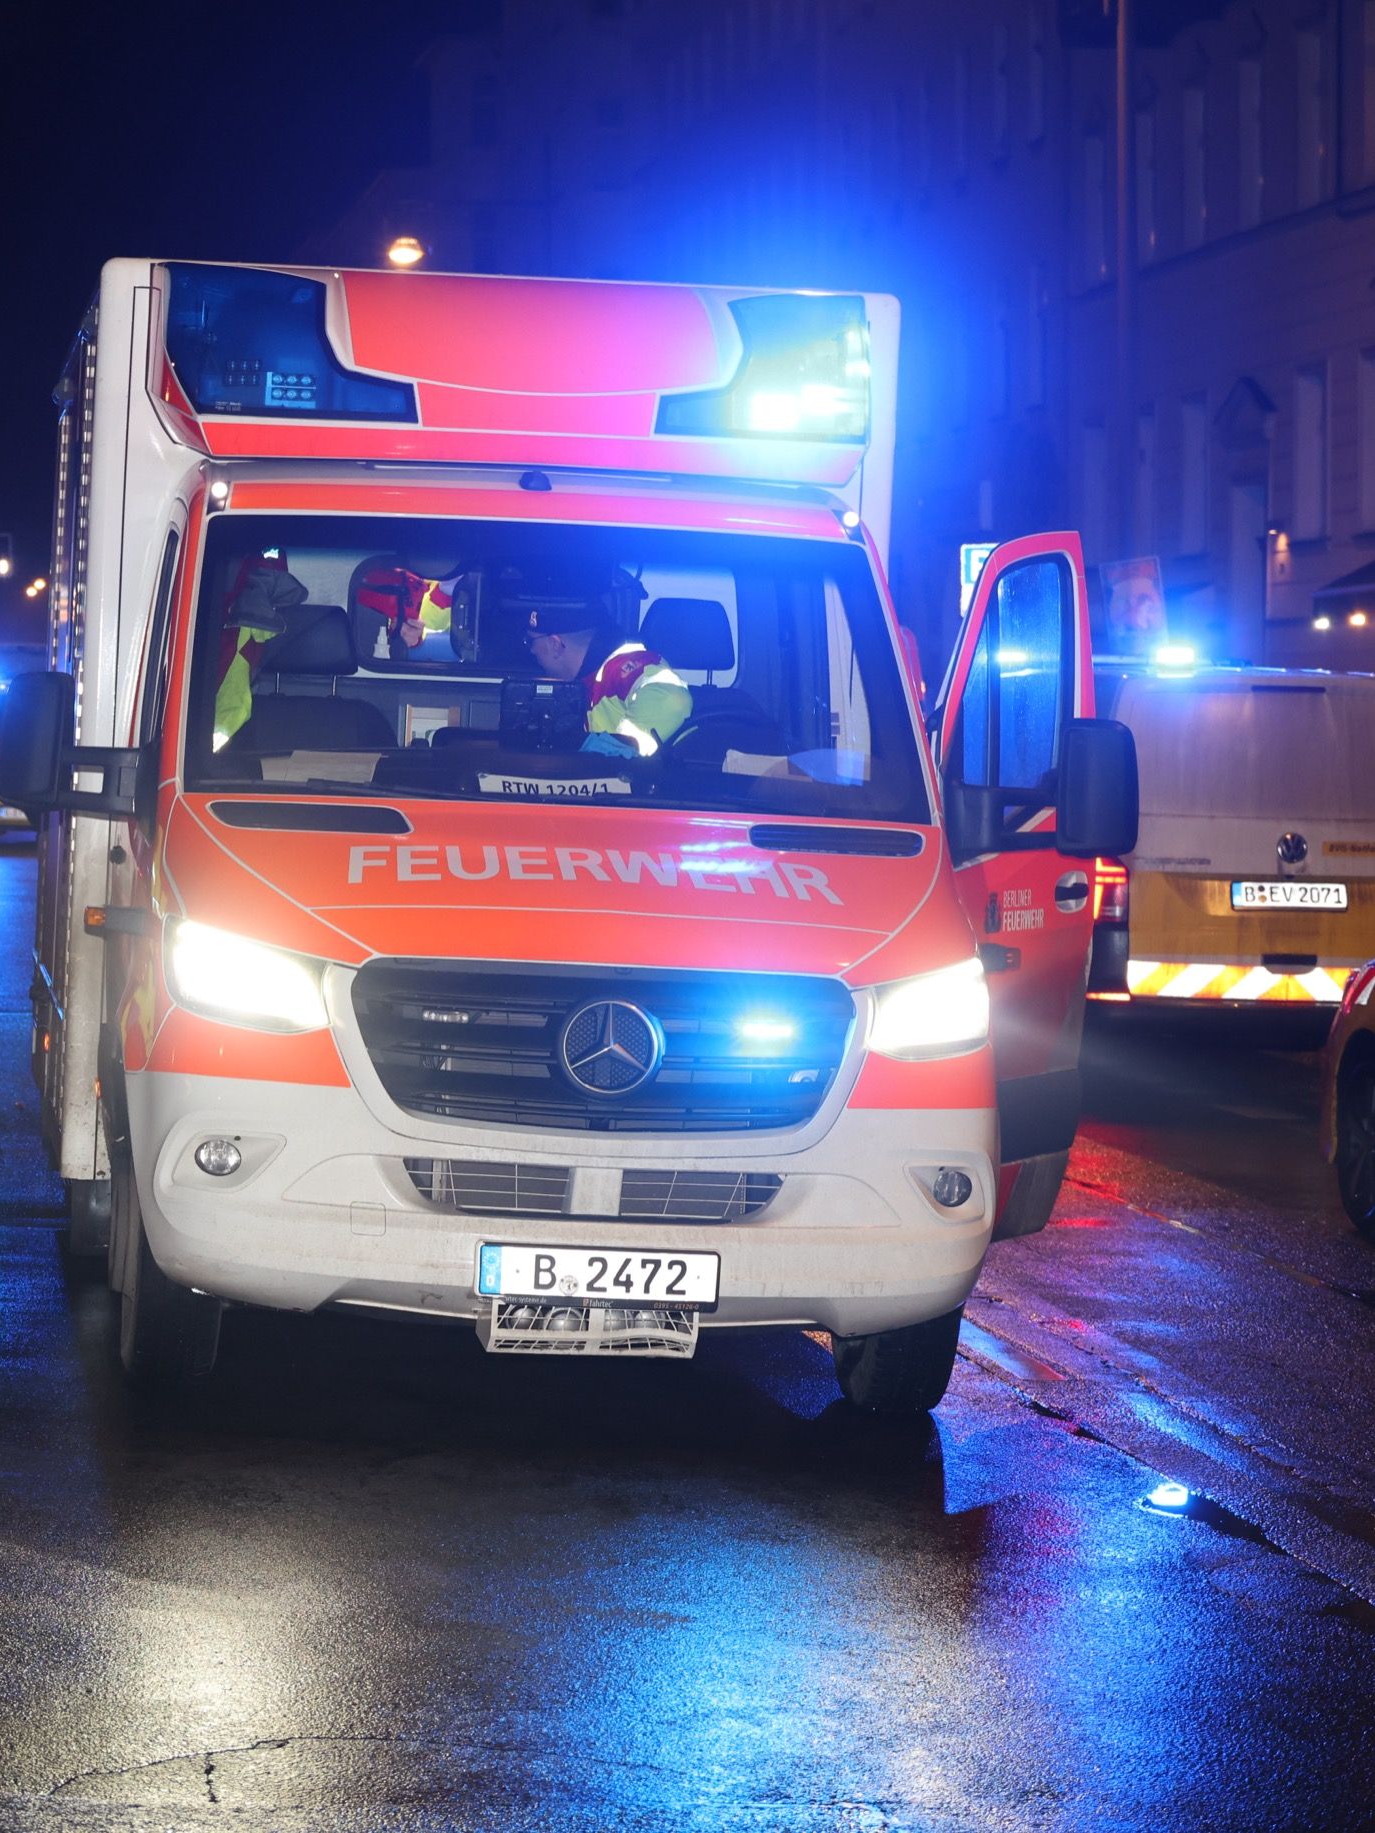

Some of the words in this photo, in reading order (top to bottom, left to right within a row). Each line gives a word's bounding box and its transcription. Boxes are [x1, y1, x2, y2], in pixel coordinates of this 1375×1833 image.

[501, 780, 540, 794] RTW
[546, 782, 609, 797] 1204/1
[346, 844, 845, 906] FEUERWEHR
[1003, 888, 1032, 908] BERLINER
[1244, 885, 1256, 902] B
[1269, 885, 1293, 902] EV
[1298, 886, 1343, 904] 2071
[1002, 908, 1045, 932] FEUERWEHR
[533, 1254, 557, 1290] B
[585, 1256, 688, 1296] 2472
